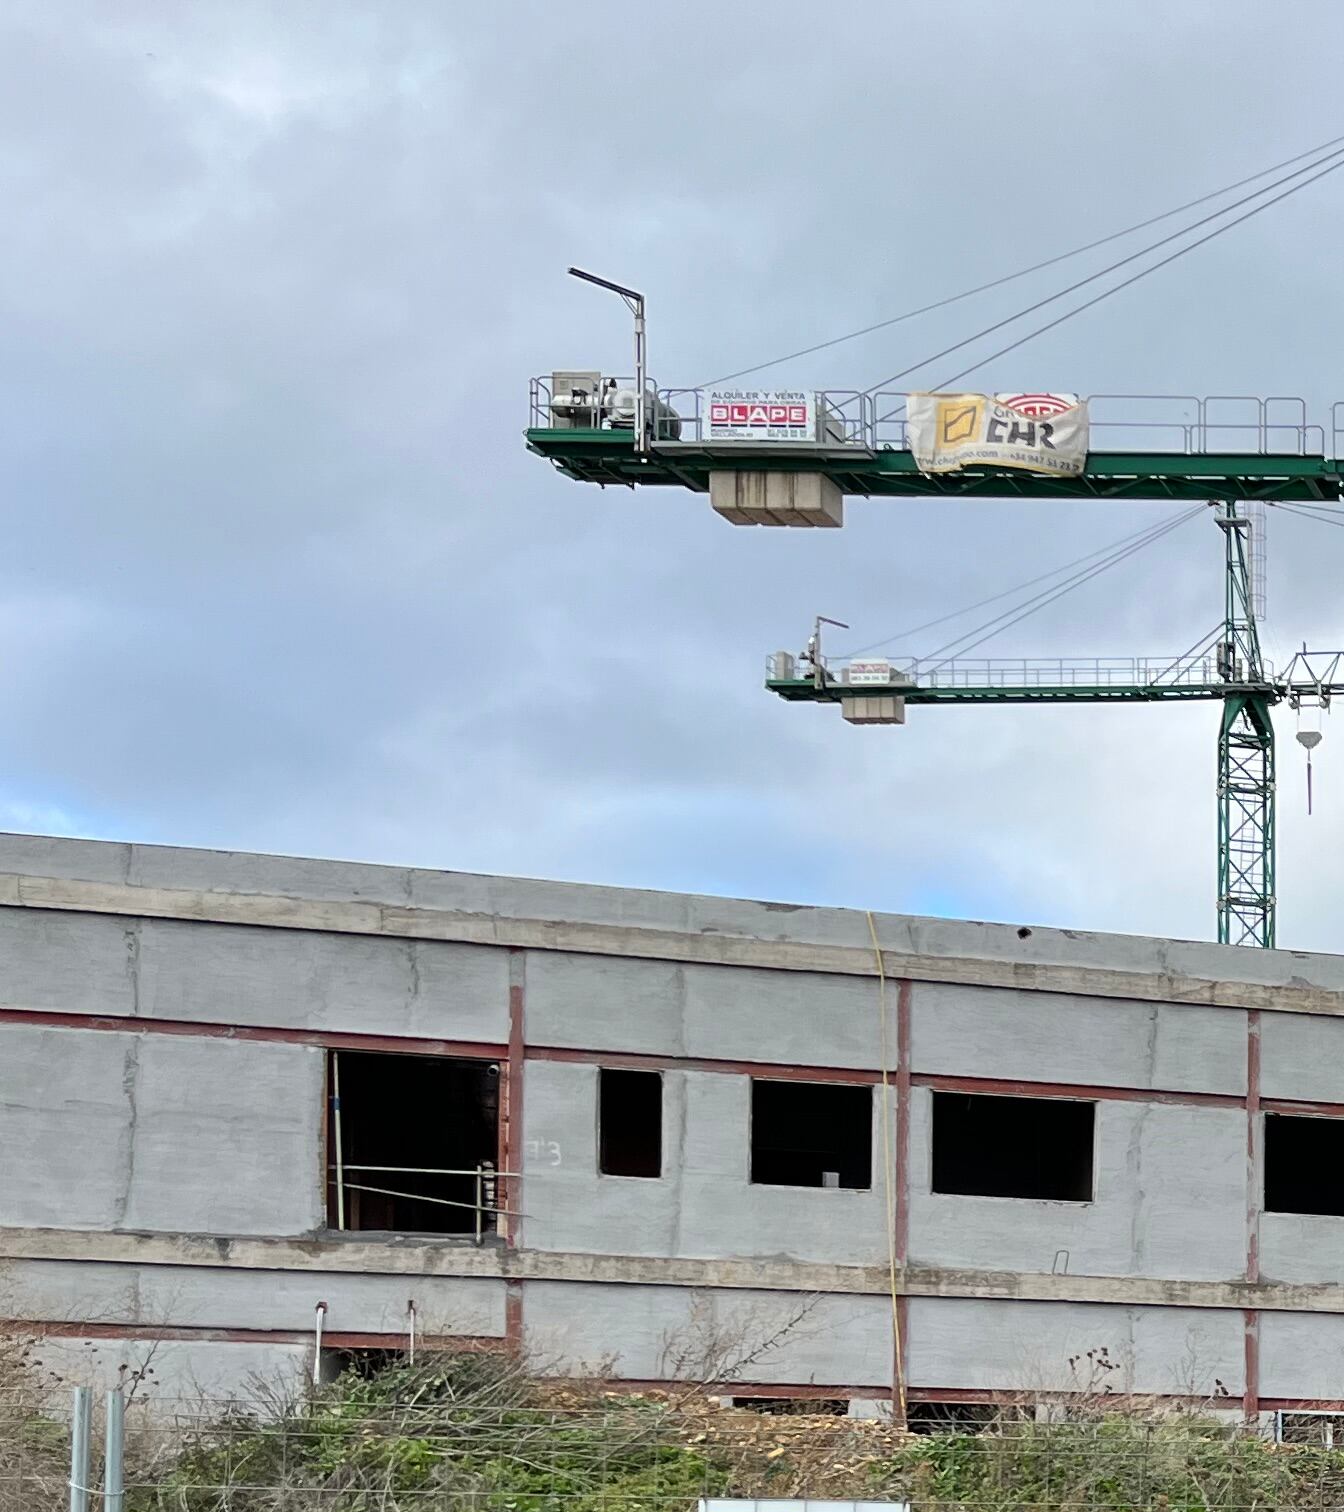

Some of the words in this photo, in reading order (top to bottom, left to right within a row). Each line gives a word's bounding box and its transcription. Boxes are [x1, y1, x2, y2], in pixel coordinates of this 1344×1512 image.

[711, 391, 759, 400] ALQUILER
[763, 392, 771, 400] Y
[774, 392, 806, 400] VENTA
[711, 406, 806, 422] BLAPE
